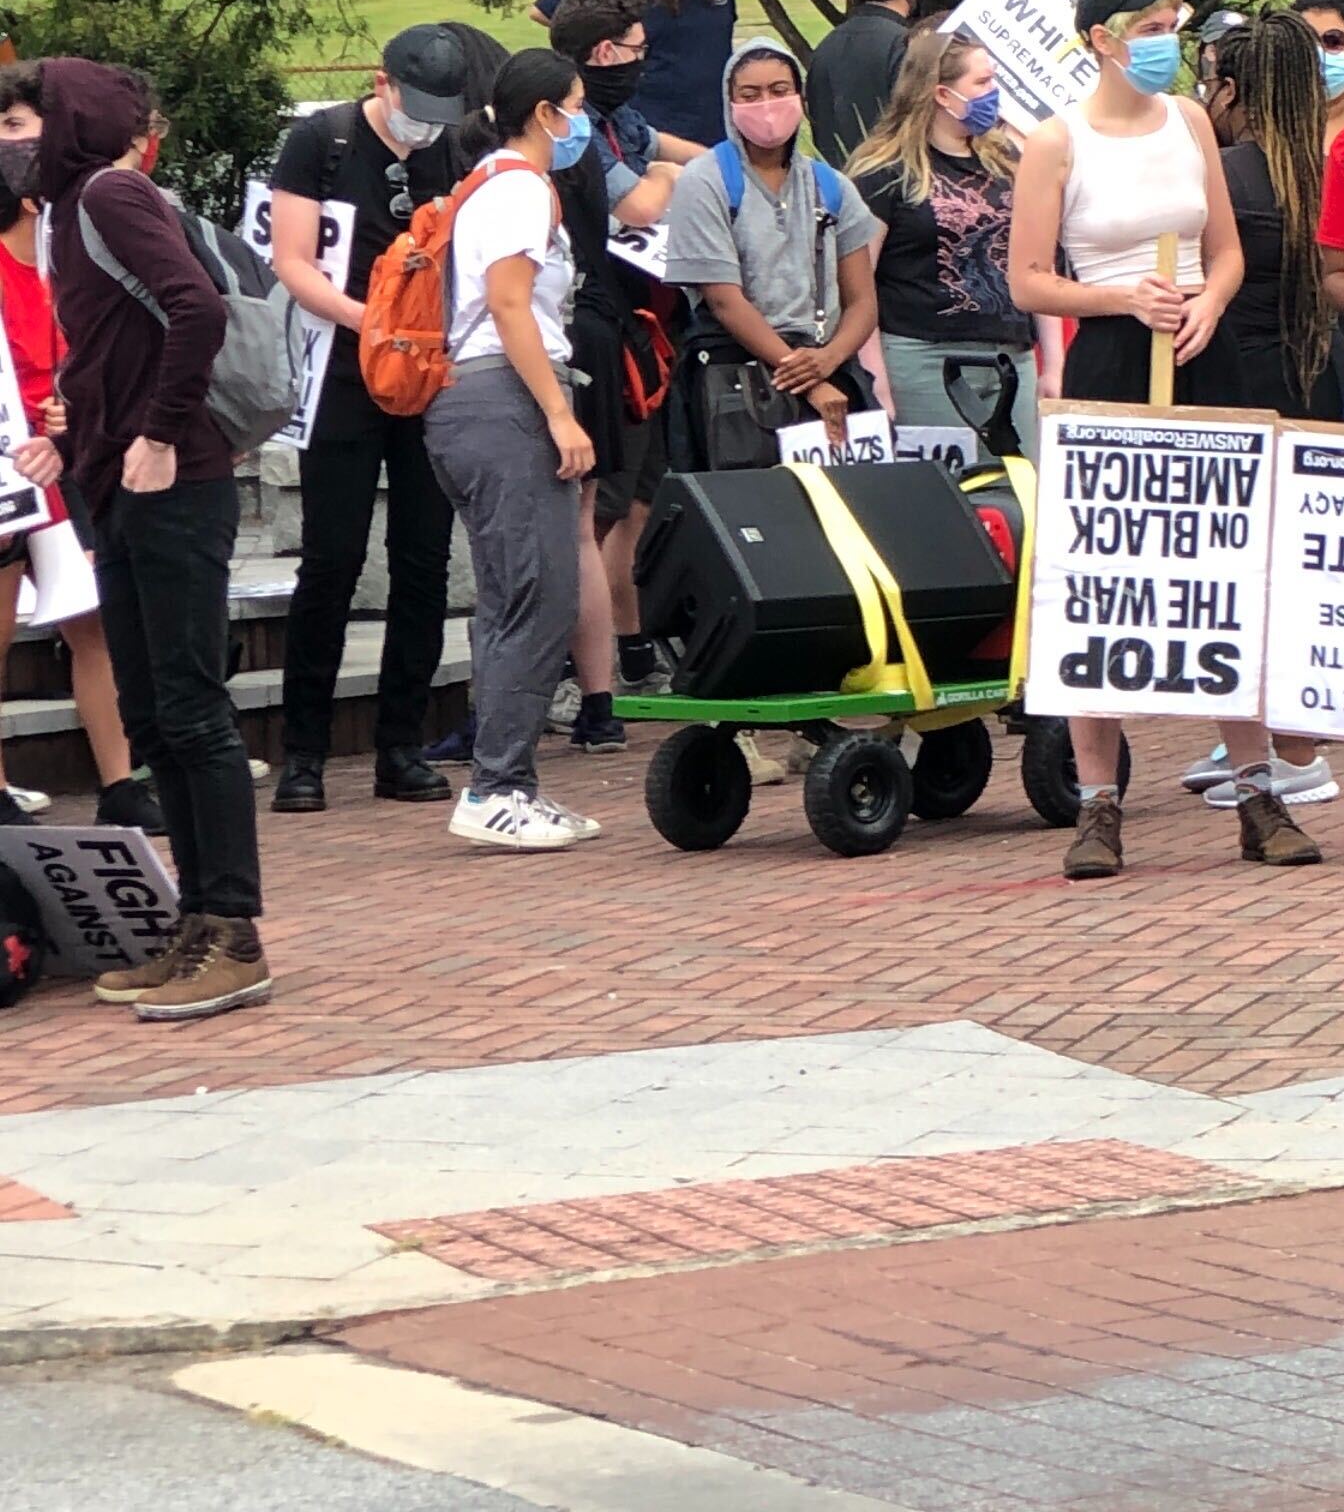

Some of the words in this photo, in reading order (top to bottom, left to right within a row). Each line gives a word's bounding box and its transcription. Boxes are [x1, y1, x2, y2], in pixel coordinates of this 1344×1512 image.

[978, 10, 1078, 107] SUPREMACY
[1065, 424, 1254, 451] ANSWERcoalition.org
[1063, 449, 1261, 508] AMERICA!
[1067, 505, 1199, 559] BLACK
[1209, 511, 1249, 550] ON
[1065, 574, 1158, 627] WAR
[1166, 578, 1242, 632] THE
[1058, 635, 1242, 696] STOP
[1300, 685, 1337, 712] TO
[26, 841, 133, 966] AGAINST
